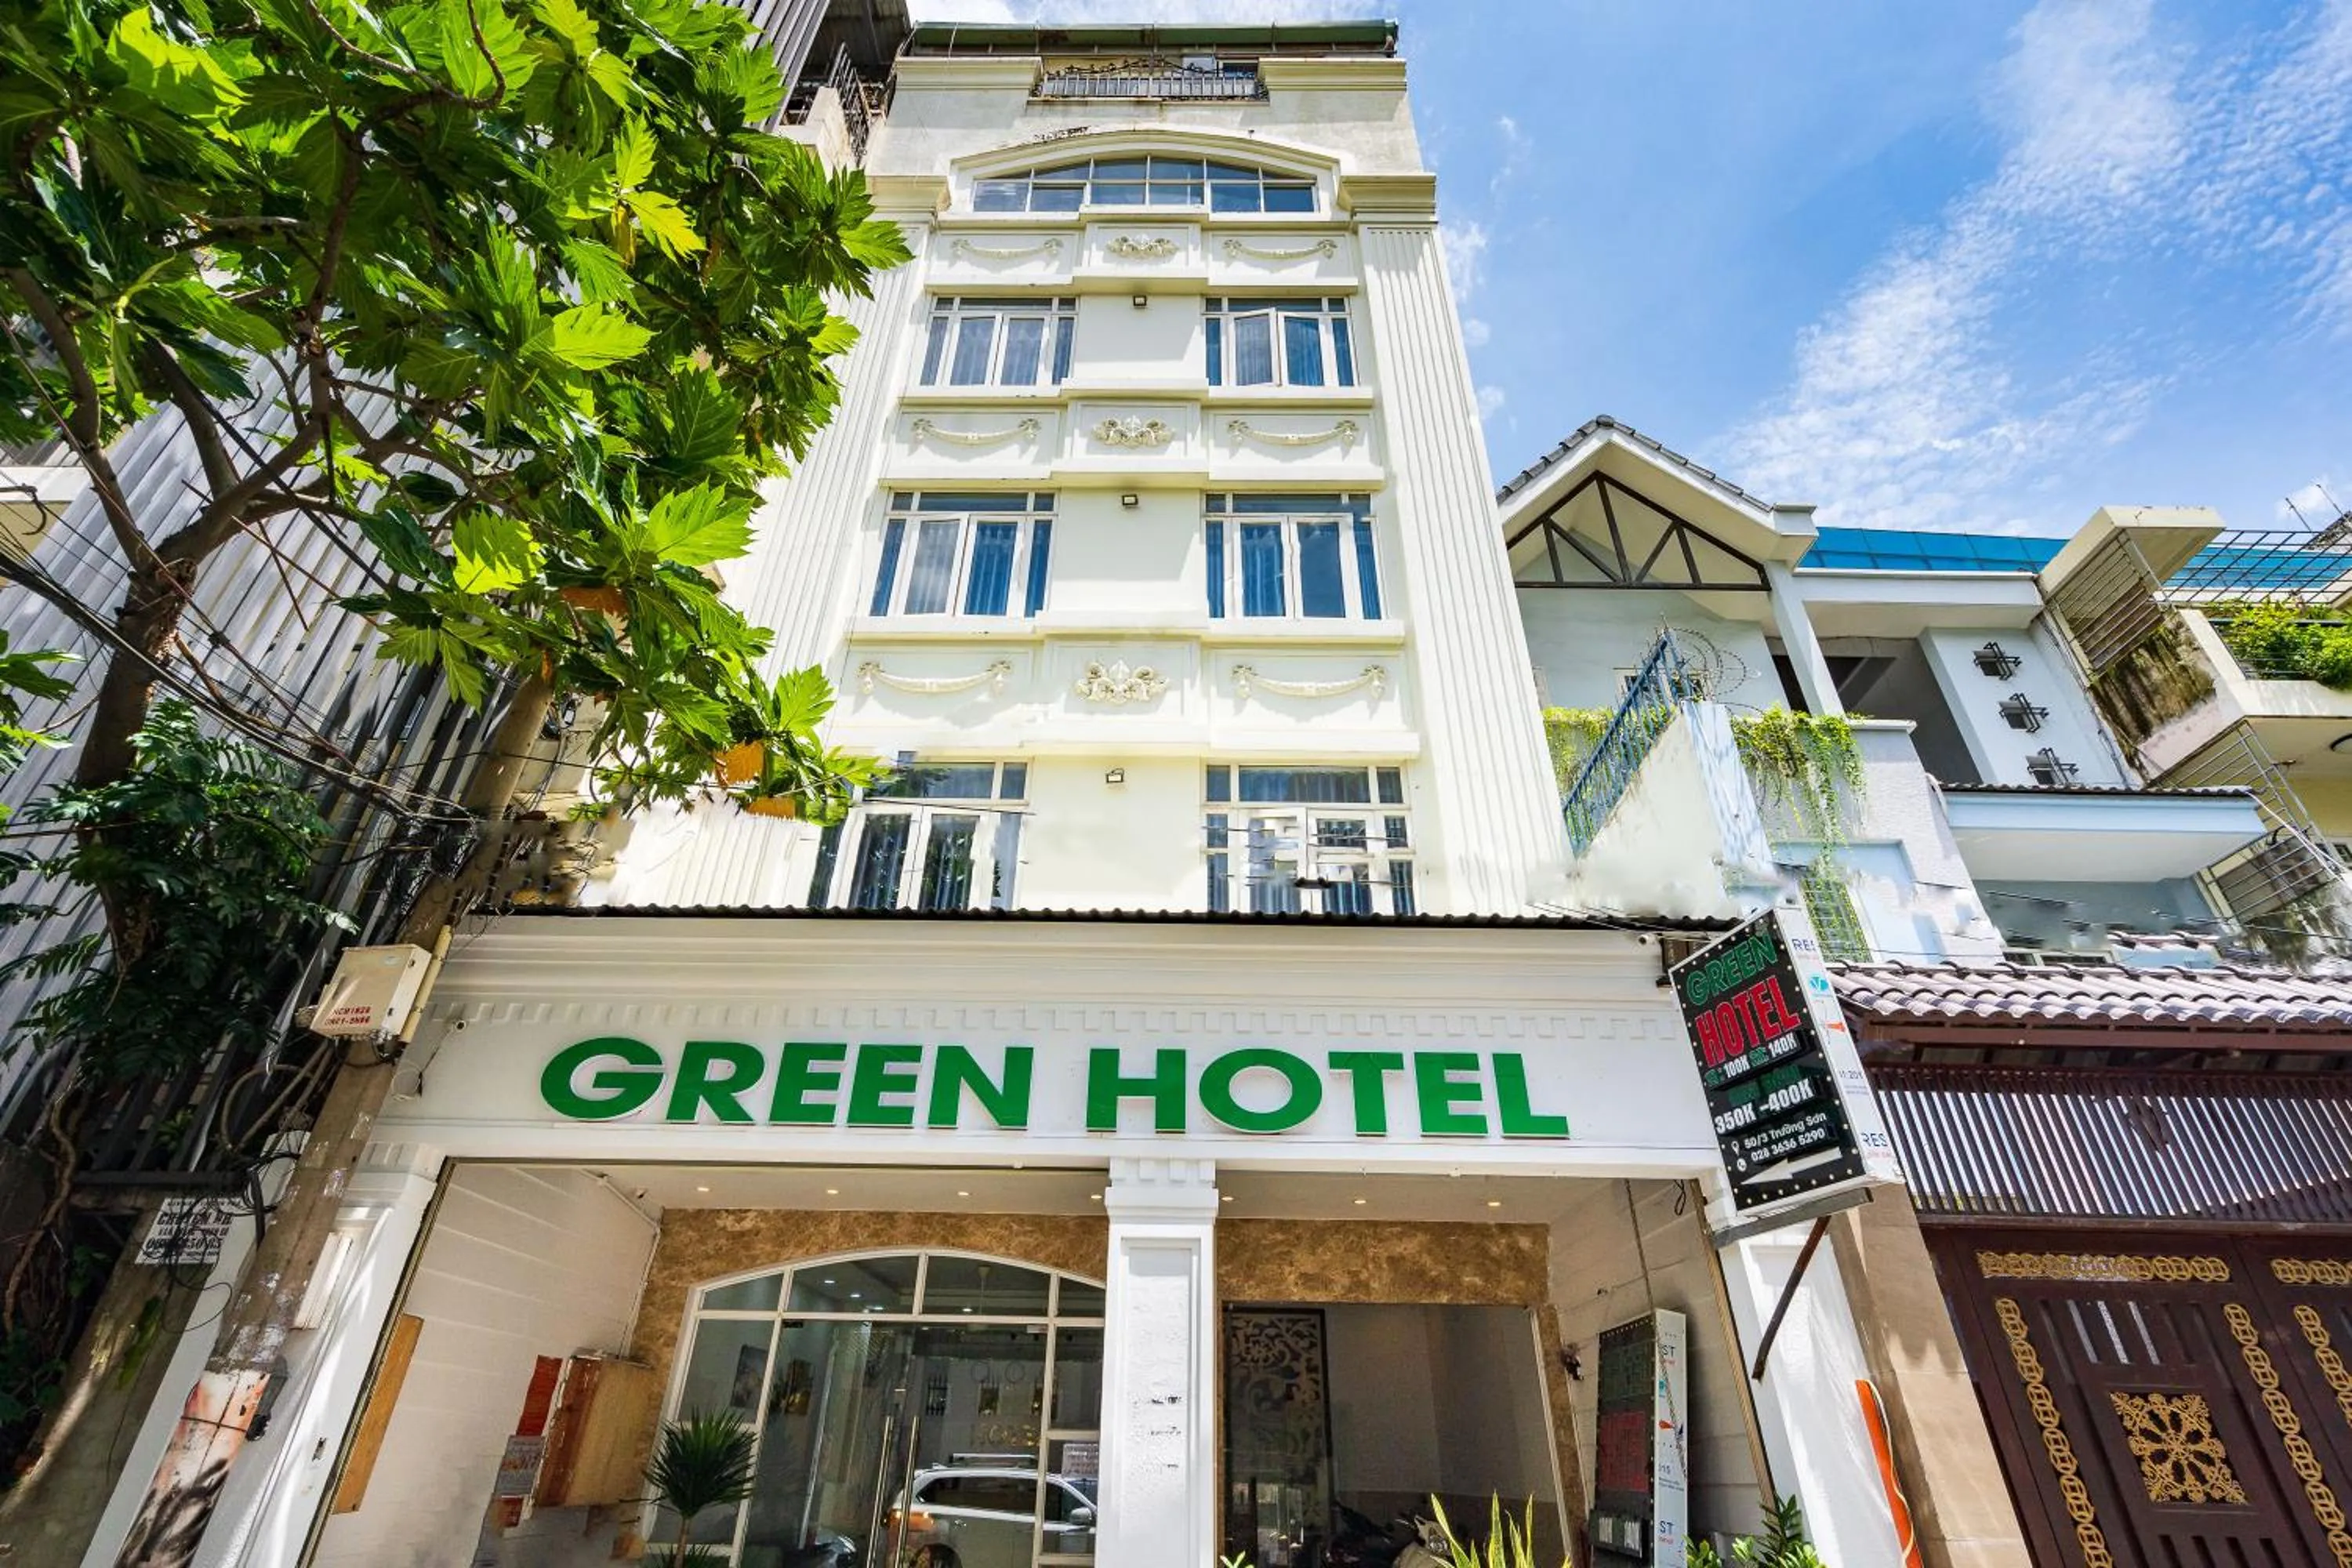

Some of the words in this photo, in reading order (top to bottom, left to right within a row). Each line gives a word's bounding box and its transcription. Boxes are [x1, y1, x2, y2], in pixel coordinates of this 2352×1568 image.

[1687, 932, 1778, 1006] GREEN
[1694, 975, 1802, 1068] HOTEL
[1723, 1054, 1751, 1079] 100K
[1768, 1032, 1797, 1058] 140K
[539, 1036, 1035, 1130] GREEN
[1086, 1047, 1570, 1139] HOTEL
[1714, 1102, 1757, 1134] 350K
[1744, 1133, 1769, 1149] 50/3
[1768, 1120, 1806, 1140] Trường
[1806, 1112, 1828, 1127] Sơn
[1771, 1138, 1798, 1156] 3636
[1798, 1127, 1826, 1145] 5290
